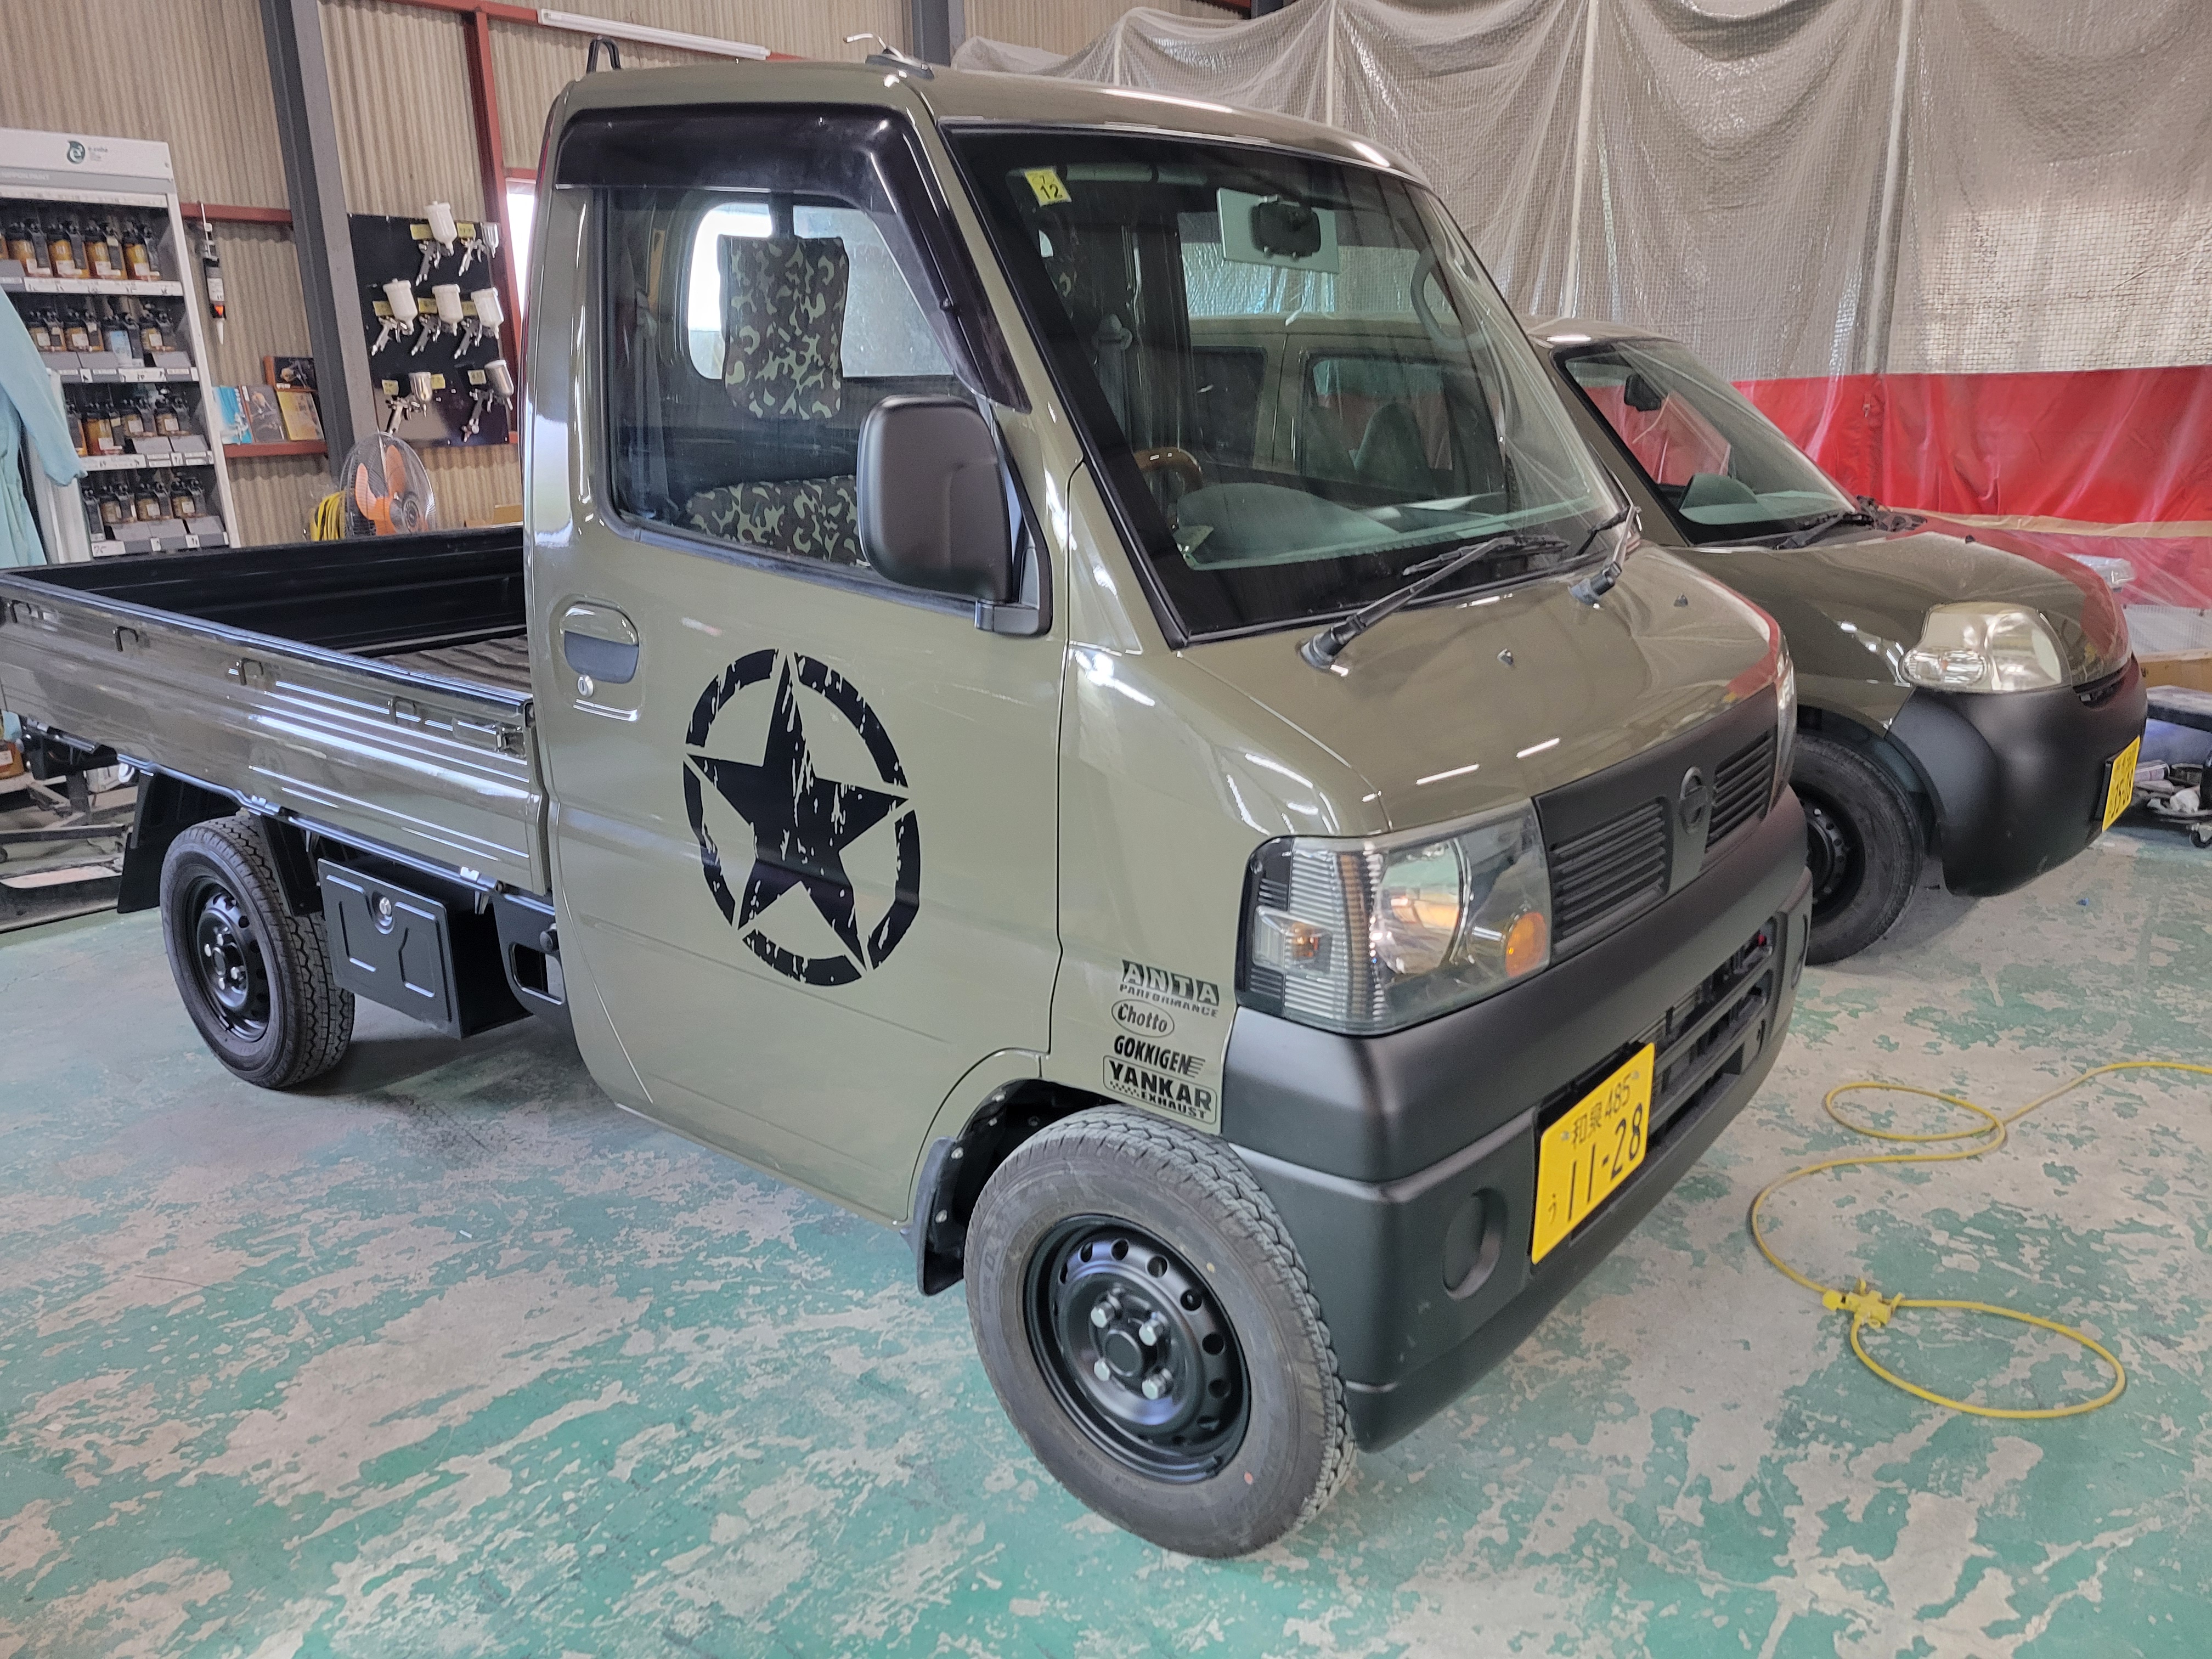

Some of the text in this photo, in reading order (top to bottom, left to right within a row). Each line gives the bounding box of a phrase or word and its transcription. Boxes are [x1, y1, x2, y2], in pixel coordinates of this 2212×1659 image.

[1040, 184, 1063, 200] 12
[1121, 960, 1219, 1007] ANTA
[1118, 1003, 1167, 1032] Chotto
[1114, 1035, 1193, 1075] GOKKIGEN
[1109, 1059, 1211, 1112] YANKAR
[1141, 1091, 1206, 1119] EXHAUST
[1572, 1073, 1630, 1149] 和泉 485
